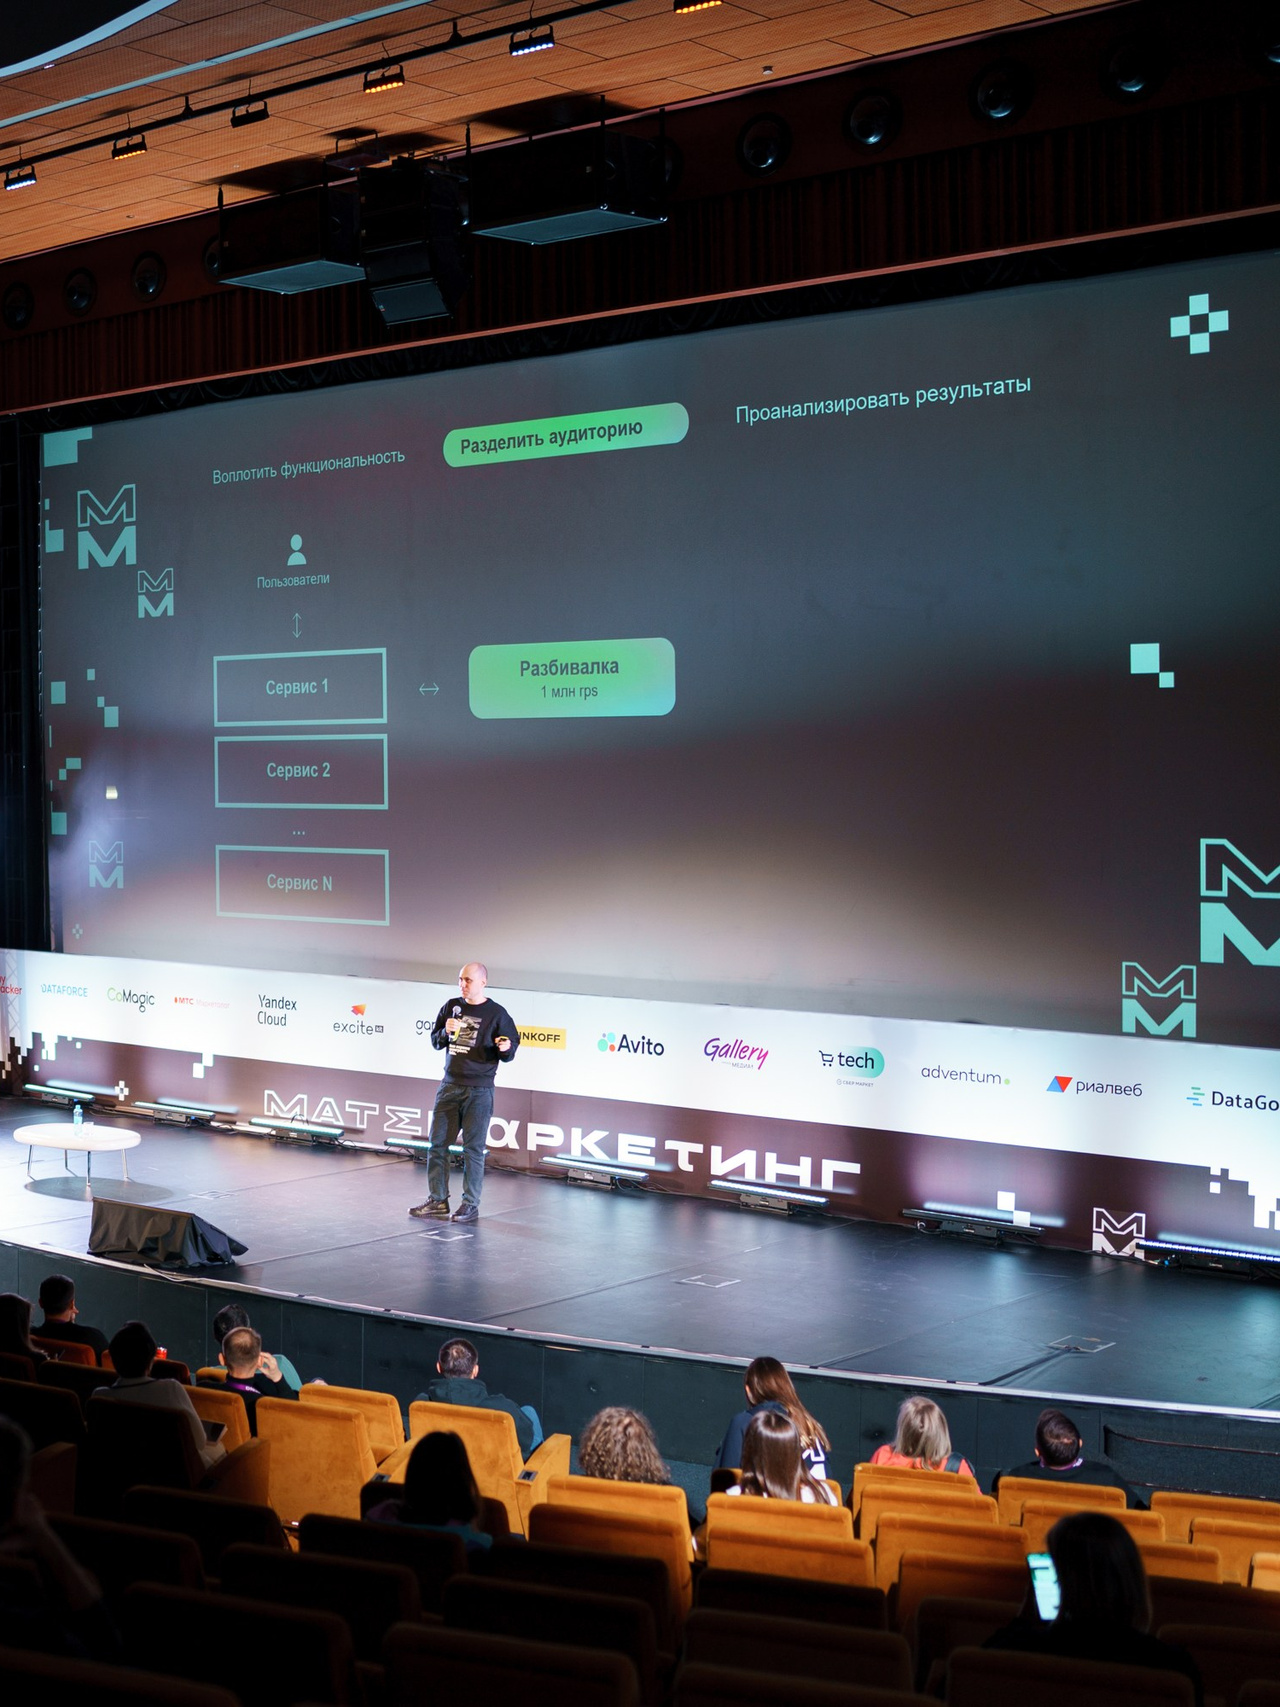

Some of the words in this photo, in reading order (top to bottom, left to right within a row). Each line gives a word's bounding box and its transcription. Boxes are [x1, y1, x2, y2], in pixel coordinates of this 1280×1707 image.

[736, 391, 910, 426] Проанализировать
[916, 378, 1031, 408] результаты
[461, 433, 544, 454] Разделить
[549, 421, 643, 447] аудиторию
[212, 466, 277, 484] Воплотить
[281, 450, 406, 479] функциональность
[257, 574, 330, 589] Пользователи
[520, 659, 619, 677] Разбивалка
[266, 680, 318, 698] Сервис
[322, 678, 328, 693] 1
[541, 685, 547, 698] 1
[551, 687, 575, 698] млн
[266, 762, 319, 781] Сервис
[322, 762, 331, 777] 2
[266, 873, 319, 893] Сервис
[322, 876, 332, 892] N
[41, 983, 88, 998] DATAFORCE
[107, 987, 155, 1013] CoMagic
[258, 994, 297, 1011] Yandex
[257, 1011, 287, 1027] Cloud
[333, 1020, 374, 1035] excite
[519, 1031, 561, 1043] INKOFF
[618, 1034, 665, 1056] Avito
[703, 1037, 769, 1070] Gallery
[837, 1052, 875, 1069] tech
[1076, 1080, 1143, 1097] риалвеб
[1212, 1090, 1280, 1111] DataGo
